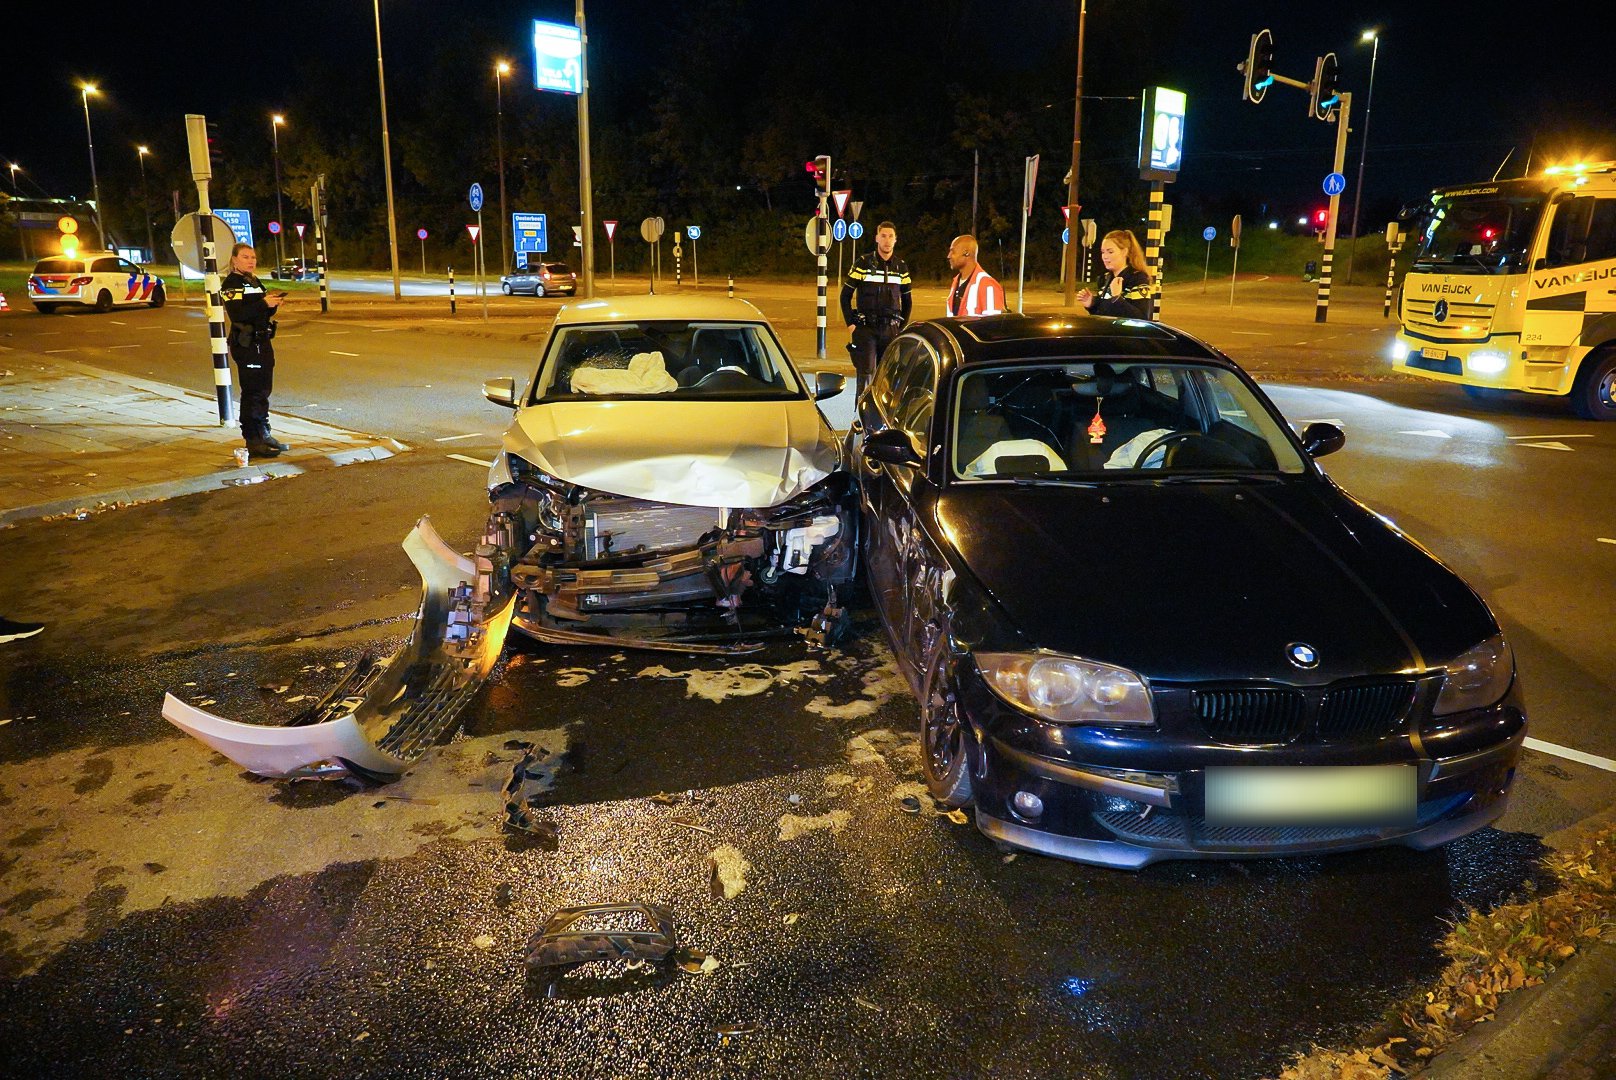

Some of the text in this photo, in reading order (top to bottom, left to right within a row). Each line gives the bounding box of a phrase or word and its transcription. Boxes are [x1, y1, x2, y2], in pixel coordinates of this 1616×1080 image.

[1421, 283, 1472, 295] VAN EIJCK
[1525, 334, 1543, 342] 224
